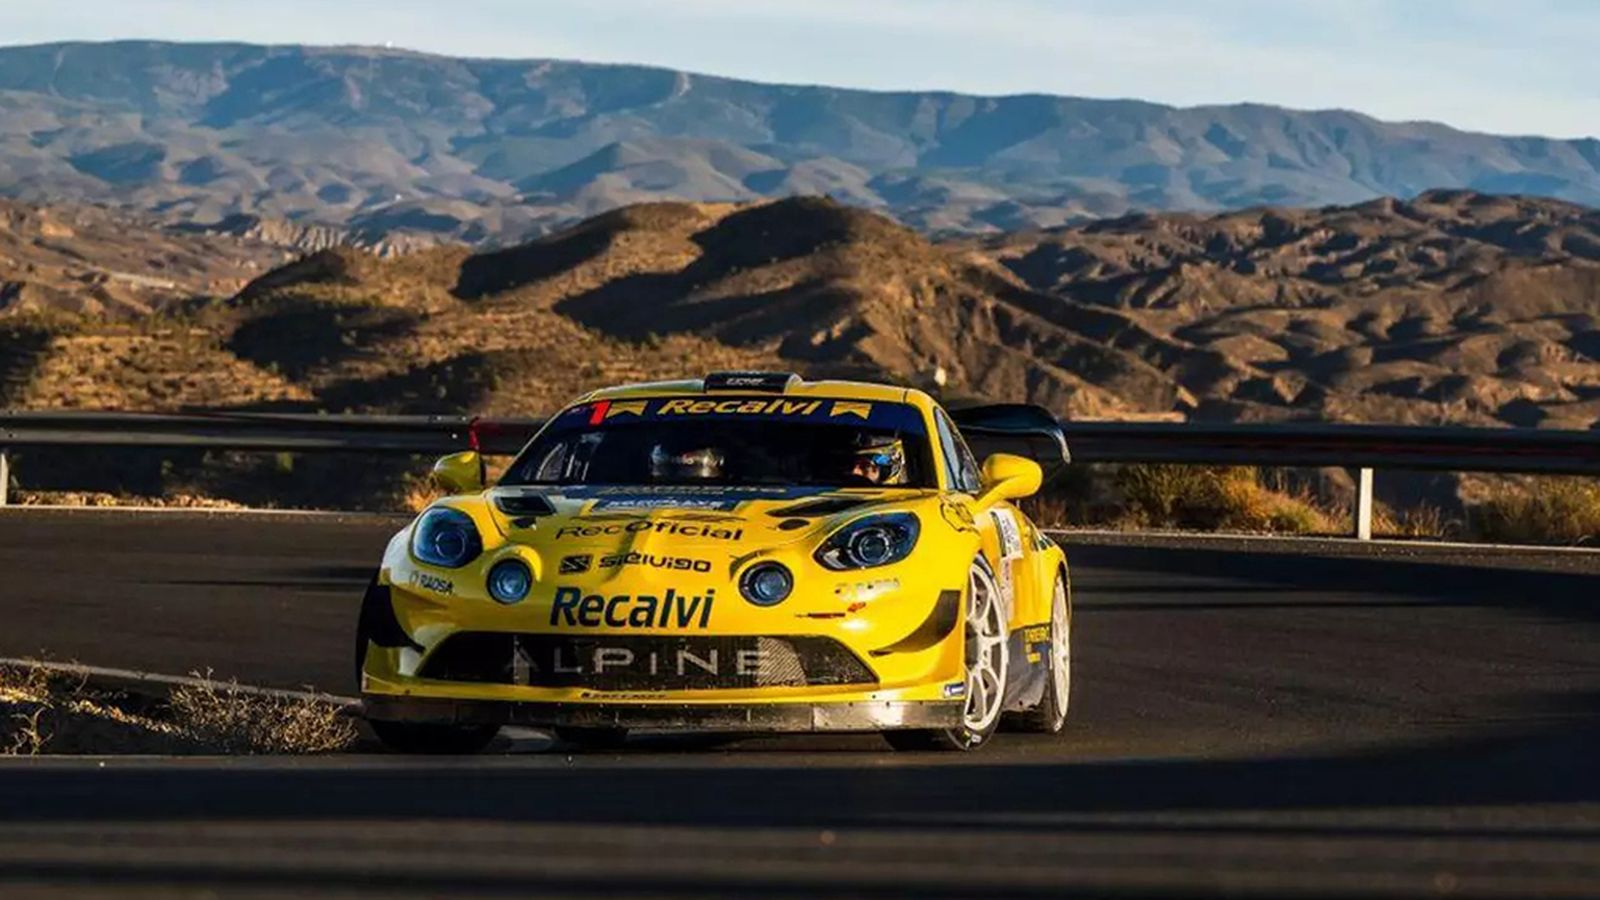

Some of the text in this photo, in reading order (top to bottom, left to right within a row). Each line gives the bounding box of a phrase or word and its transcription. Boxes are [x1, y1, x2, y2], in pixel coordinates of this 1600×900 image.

[657, 399, 820, 416] Recalvi
[555, 520, 743, 541] RecOficial
[550, 586, 716, 629] Recalvi
[504, 647, 771, 676] ALPINE
